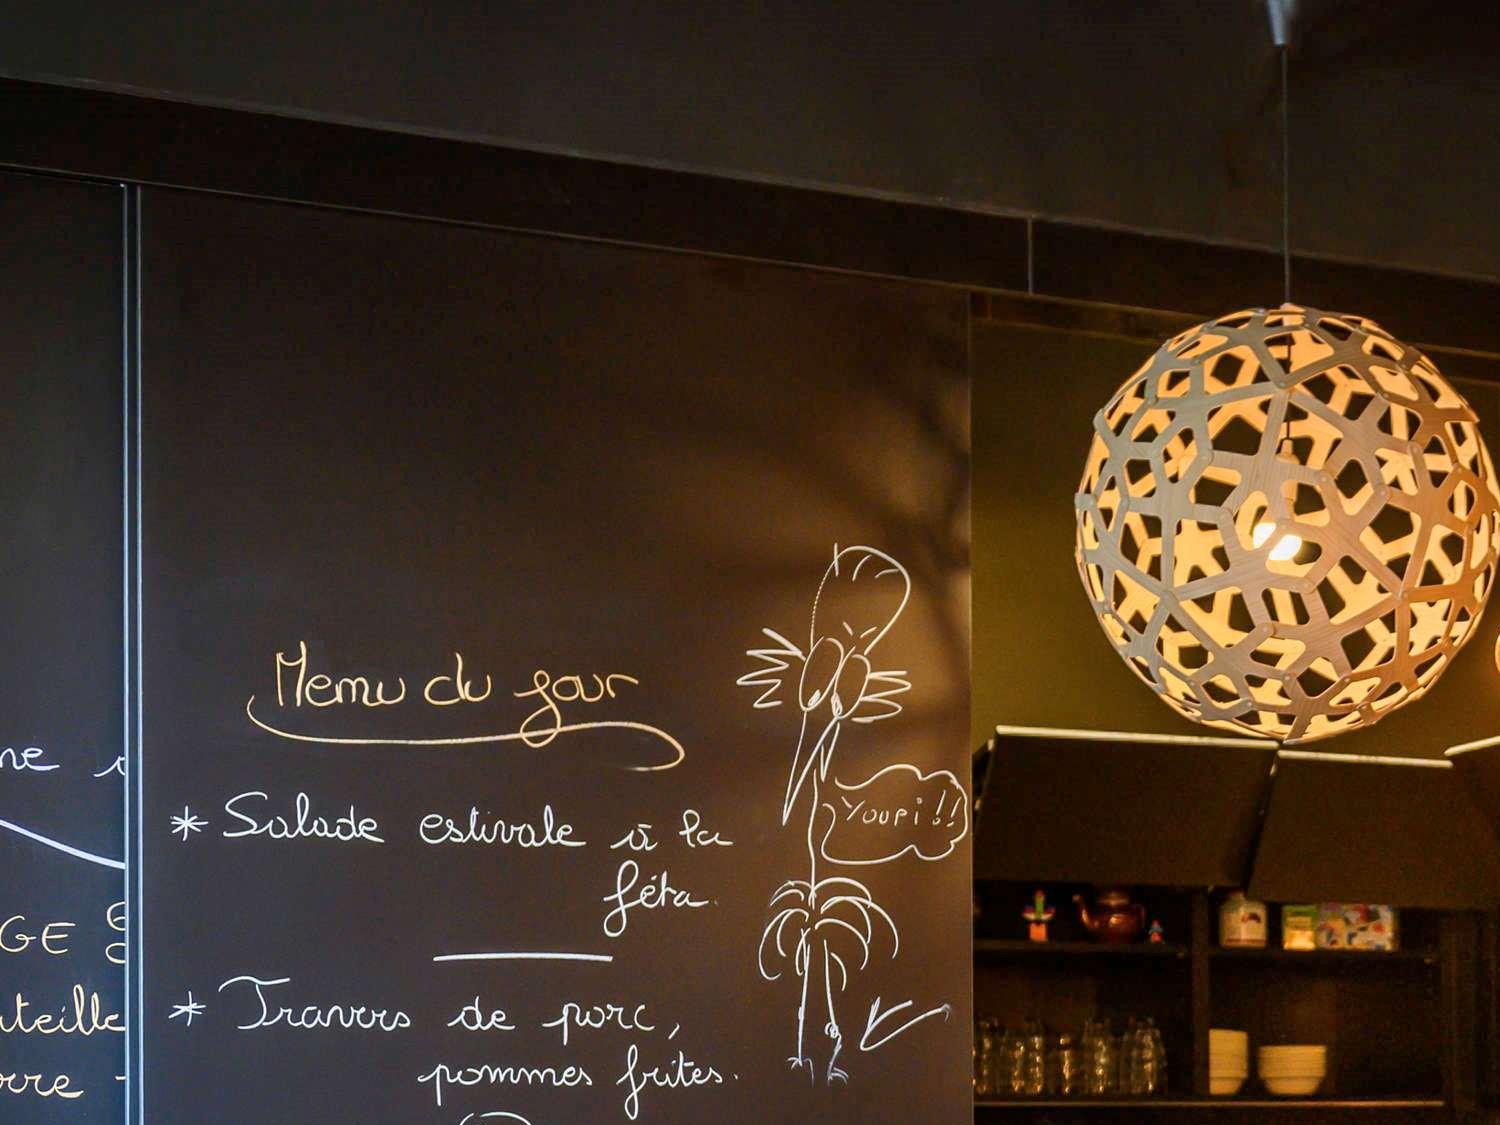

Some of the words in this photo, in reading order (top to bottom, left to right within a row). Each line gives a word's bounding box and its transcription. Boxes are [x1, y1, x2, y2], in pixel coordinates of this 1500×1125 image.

[276, 641, 406, 707] Menu
[424, 652, 492, 705] du
[514, 671, 639, 748] jour
[223, 791, 384, 843] Salade
[420, 805, 586, 847] estivale
[679, 809, 733, 845] la
[218, 976, 410, 1031] Travers
[447, 996, 515, 1030] de
[542, 1003, 680, 1039] porc,
[418, 1064, 592, 1106] pommes
